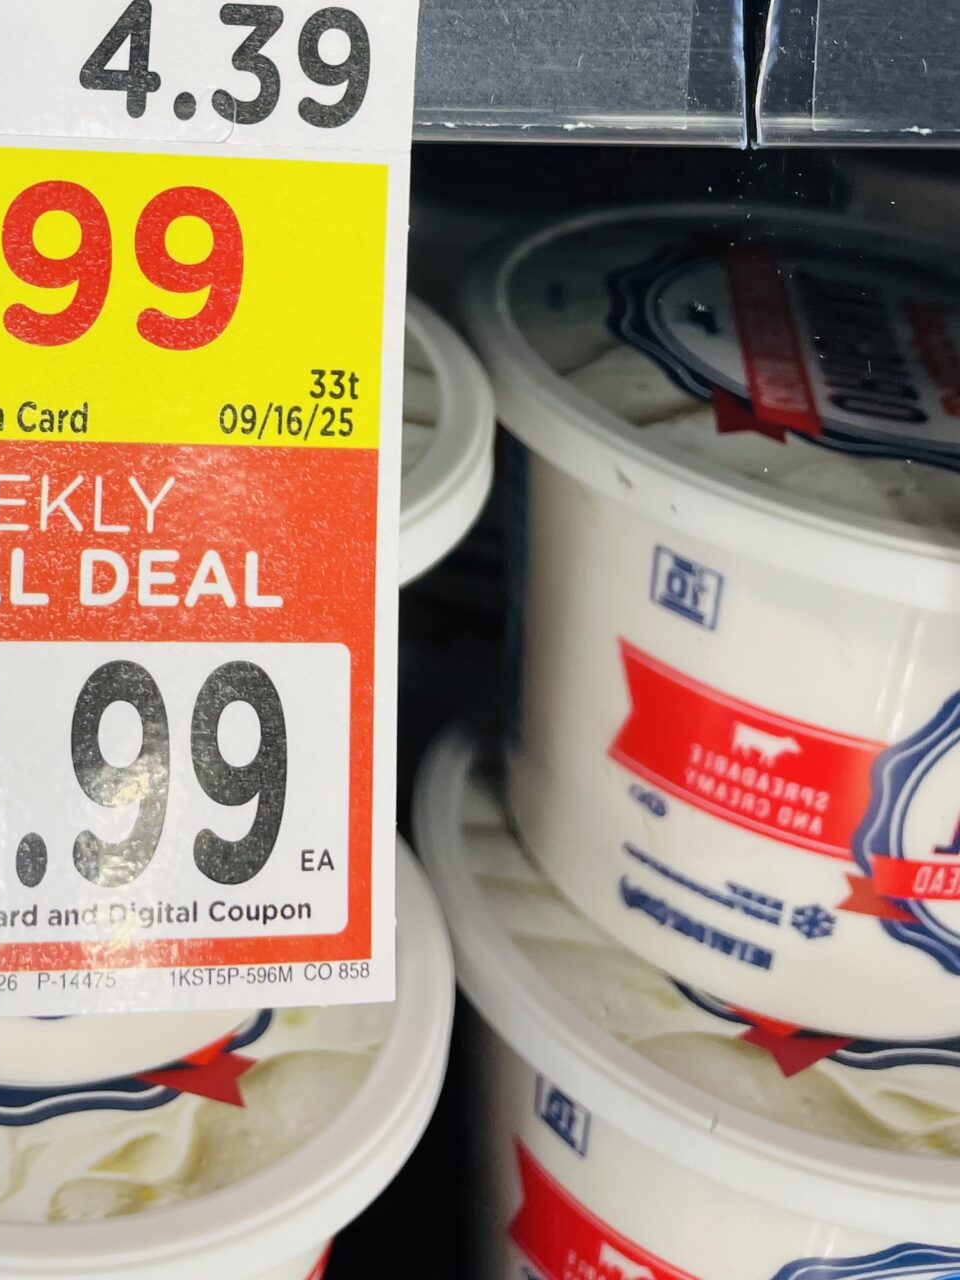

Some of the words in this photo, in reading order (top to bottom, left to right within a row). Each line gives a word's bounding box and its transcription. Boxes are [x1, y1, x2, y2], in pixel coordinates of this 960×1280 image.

[310, 368, 362, 401] 33t
[16, 400, 90, 435] Card
[217, 404, 355, 440] 09/16/25
[78, 547, 284, 609] DEAL
[300, 848, 335, 873] EA
[48, 902, 99, 926] and
[108, 900, 198, 929] Digital
[208, 901, 311, 926] Coupon
[37, 971, 117, 991] P-14475
[170, 966, 293, 987] 1KST5P-596M
[304, 963, 333, 982] CO
[338, 961, 370, 980] 858
